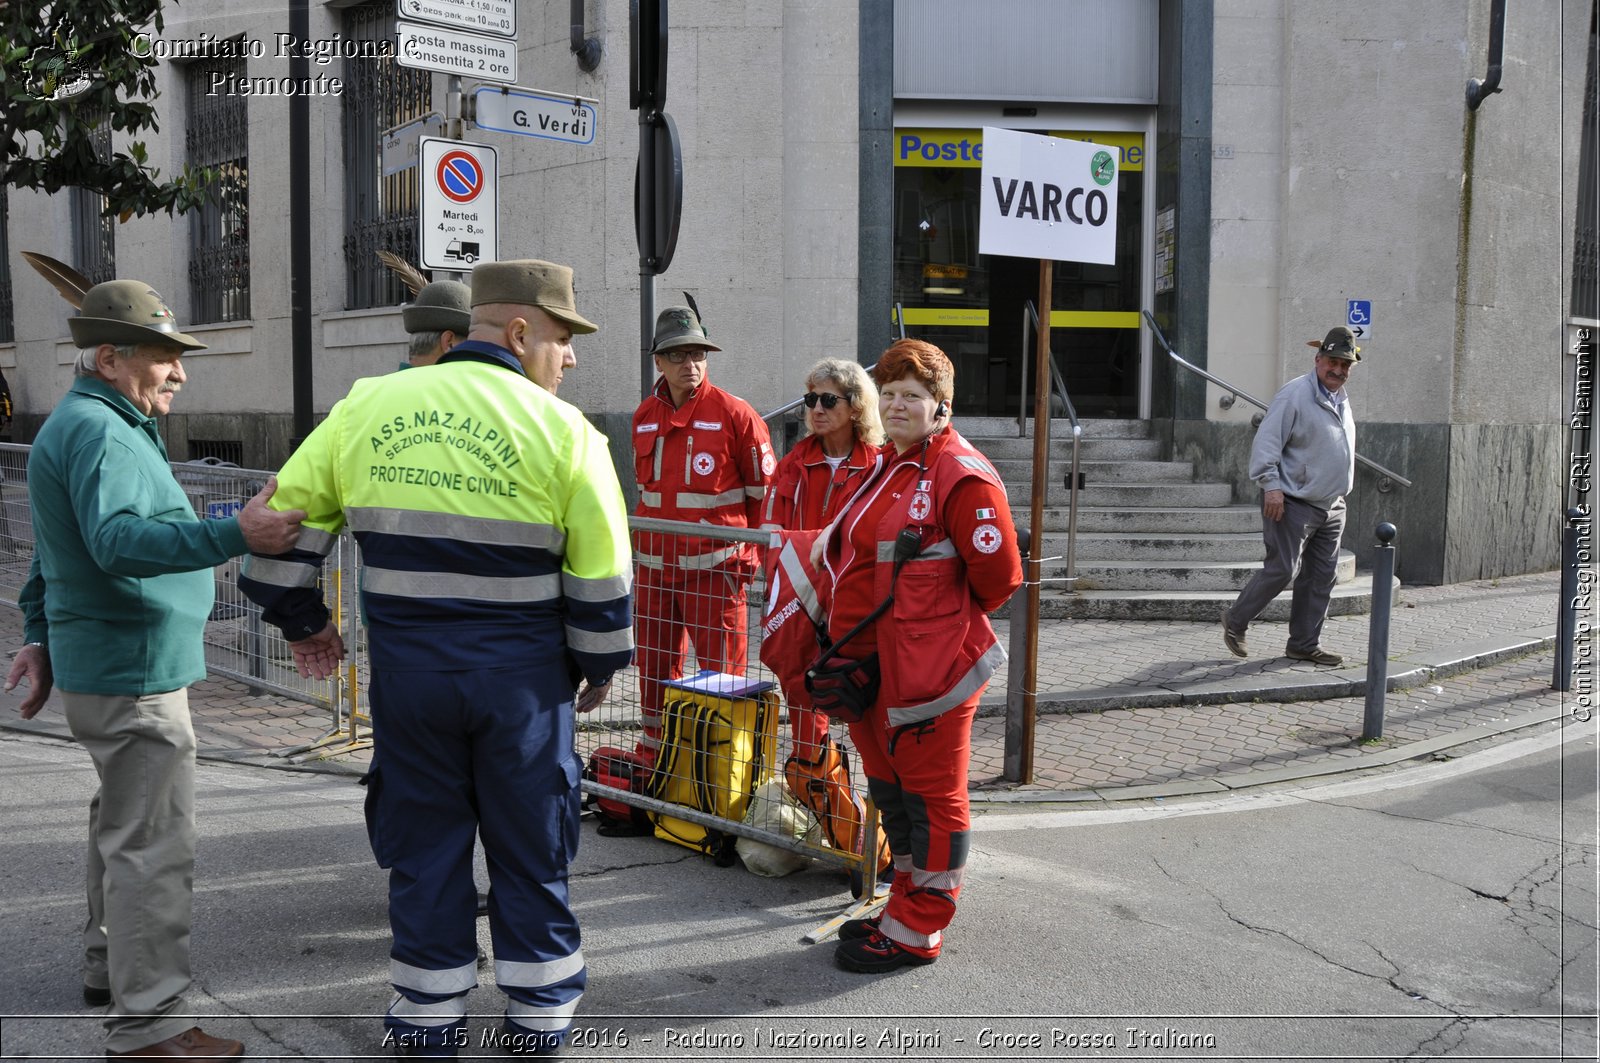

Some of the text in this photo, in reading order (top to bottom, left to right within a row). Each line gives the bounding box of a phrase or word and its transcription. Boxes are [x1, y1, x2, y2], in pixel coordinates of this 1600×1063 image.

[477, 1, 490, 11] 1,50
[495, 6, 507, 14] ora
[477, 14, 487, 25] 10
[500, 19, 510, 29] 03
[410, 34, 506, 59] sosta massima
[478, 59, 485, 70] 2
[489, 63, 510, 74] ore
[513, 110, 587, 137] G. Verdi
[571, 107, 587, 118] via
[900, 135, 983, 161] Poste
[992, 176, 1109, 227] VARCO
[437, 222, 456, 233] 4,00
[466, 224, 485, 235] 8,00
[385, 432, 498, 473] SEZIONE NOVARA
[370, 465, 518, 498] PROTEZIONE CIVILE
